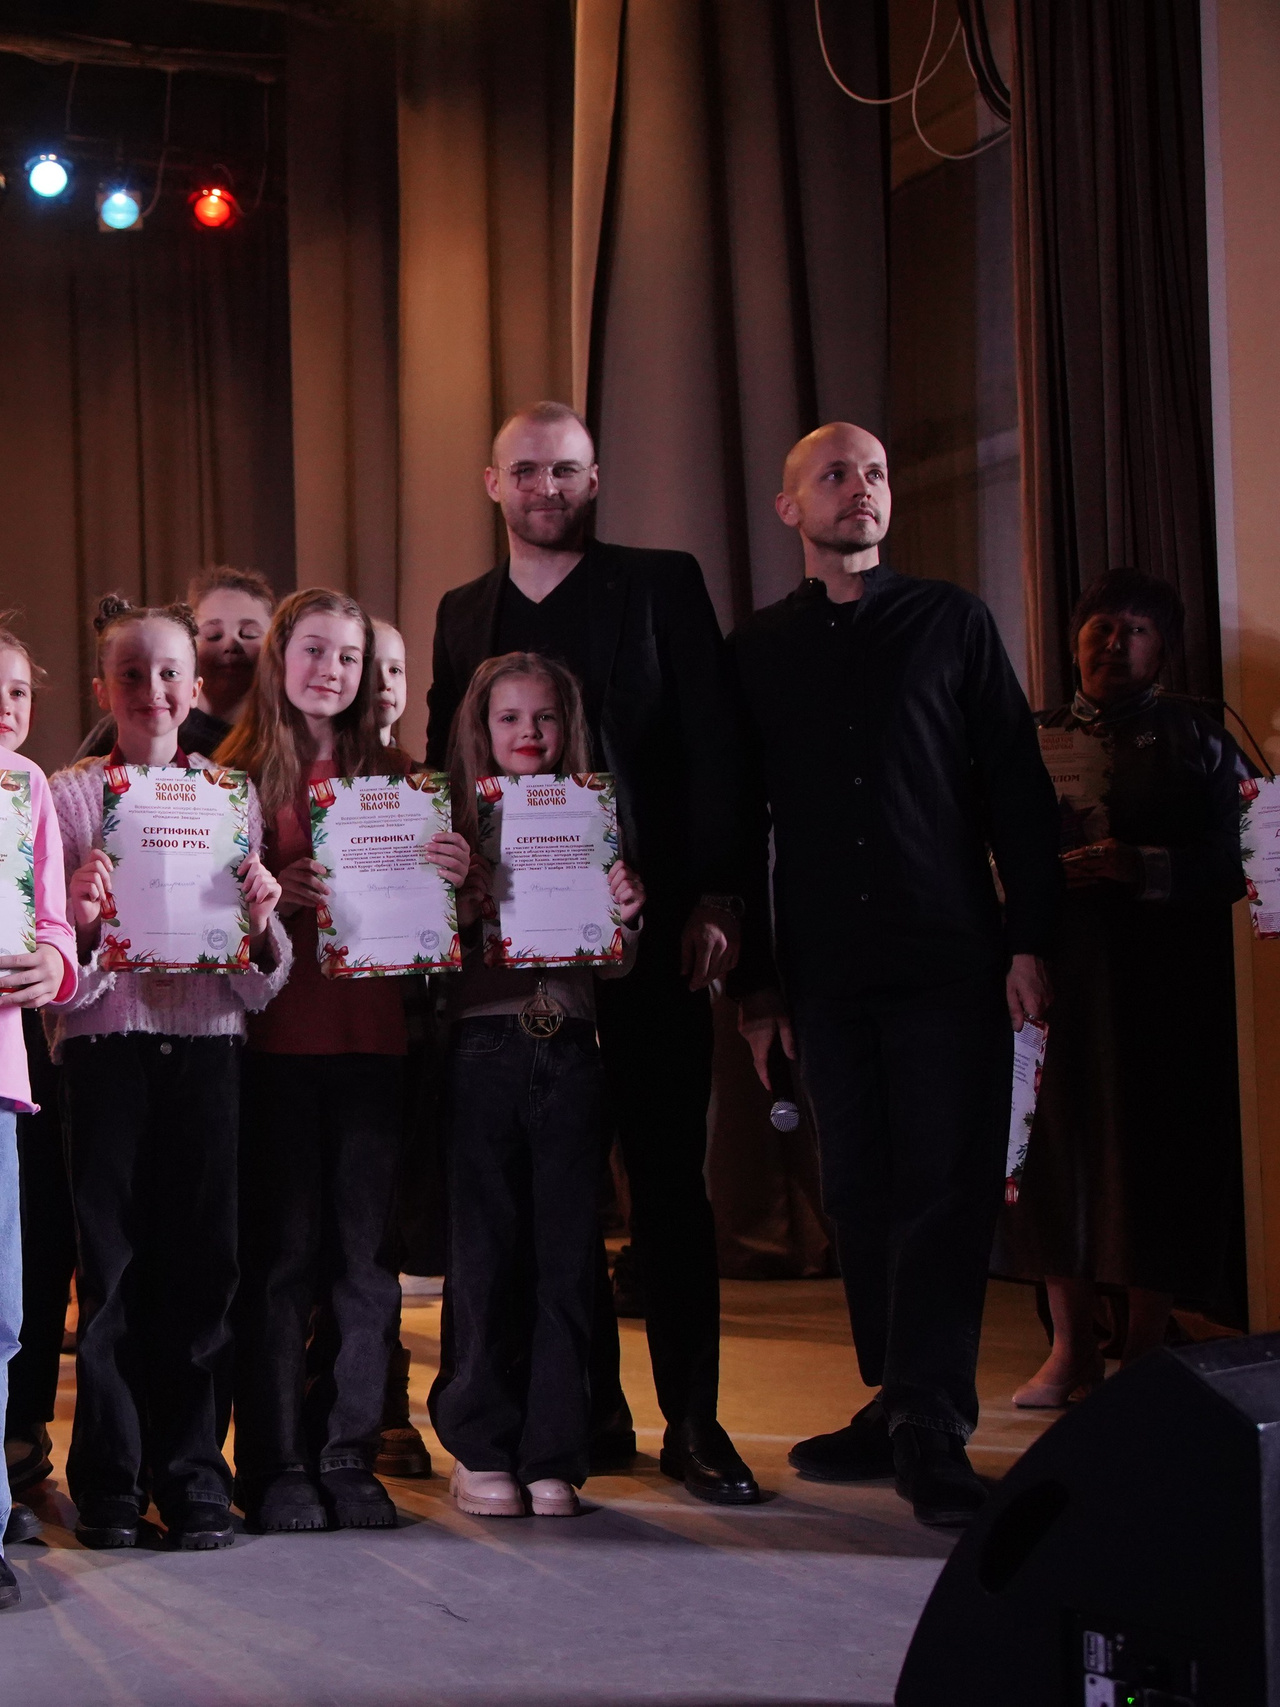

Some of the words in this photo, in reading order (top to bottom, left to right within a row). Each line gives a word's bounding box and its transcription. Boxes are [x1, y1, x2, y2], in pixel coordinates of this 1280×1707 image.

[155, 783, 196, 793] ЗОЛОТОЕ
[526, 788, 566, 797] ЗОЛОТОЕ
[156, 792, 196, 801] ЯБЛОЧКО
[360, 792, 399, 801] ЗОЛОТОЕ
[360, 801, 400, 811] ЯБЛОЧКО
[527, 797, 566, 806] ЯБЛОЧКО
[143, 826, 210, 835] СЕРТИФИКАТ
[351, 834, 415, 844] СЕРТИФИКАТ
[516, 835, 581, 843] СЕРТИФИКАТ
[141, 839, 178, 848] 25000
[183, 840, 210, 849] РУБ.
